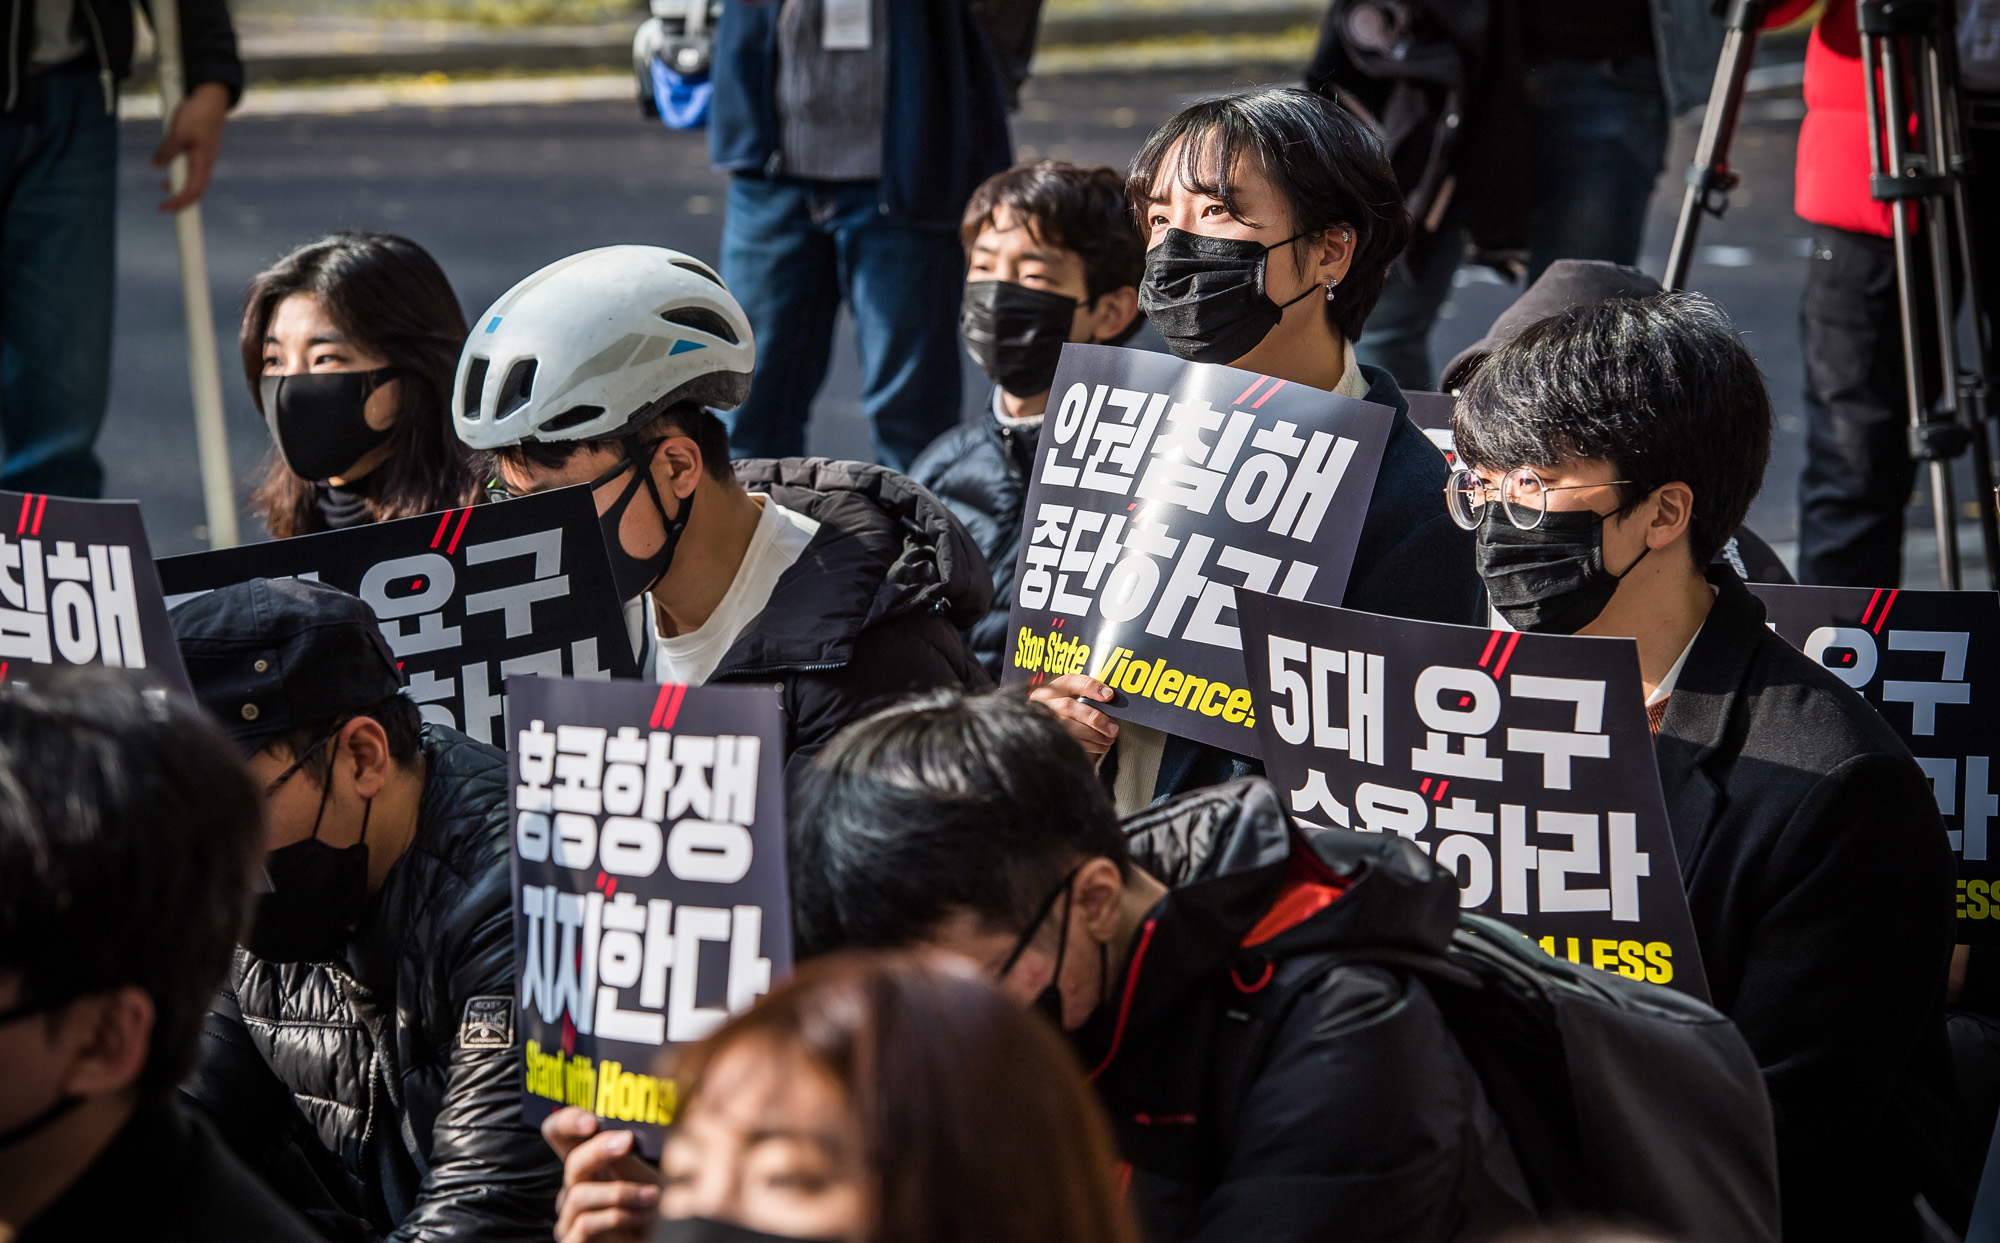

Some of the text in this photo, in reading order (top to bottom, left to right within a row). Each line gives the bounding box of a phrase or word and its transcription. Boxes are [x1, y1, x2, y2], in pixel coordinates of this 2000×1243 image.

[1040, 382, 1359, 543] 인권침해
[359, 527, 570, 656] 요구
[1014, 626, 1045, 674] Stop
[1044, 631, 1090, 676] State
[1267, 634, 1610, 790] 5대 요구
[516, 720, 761, 883] 홍콩항쟁
[522, 885, 771, 1045] 지지한다
